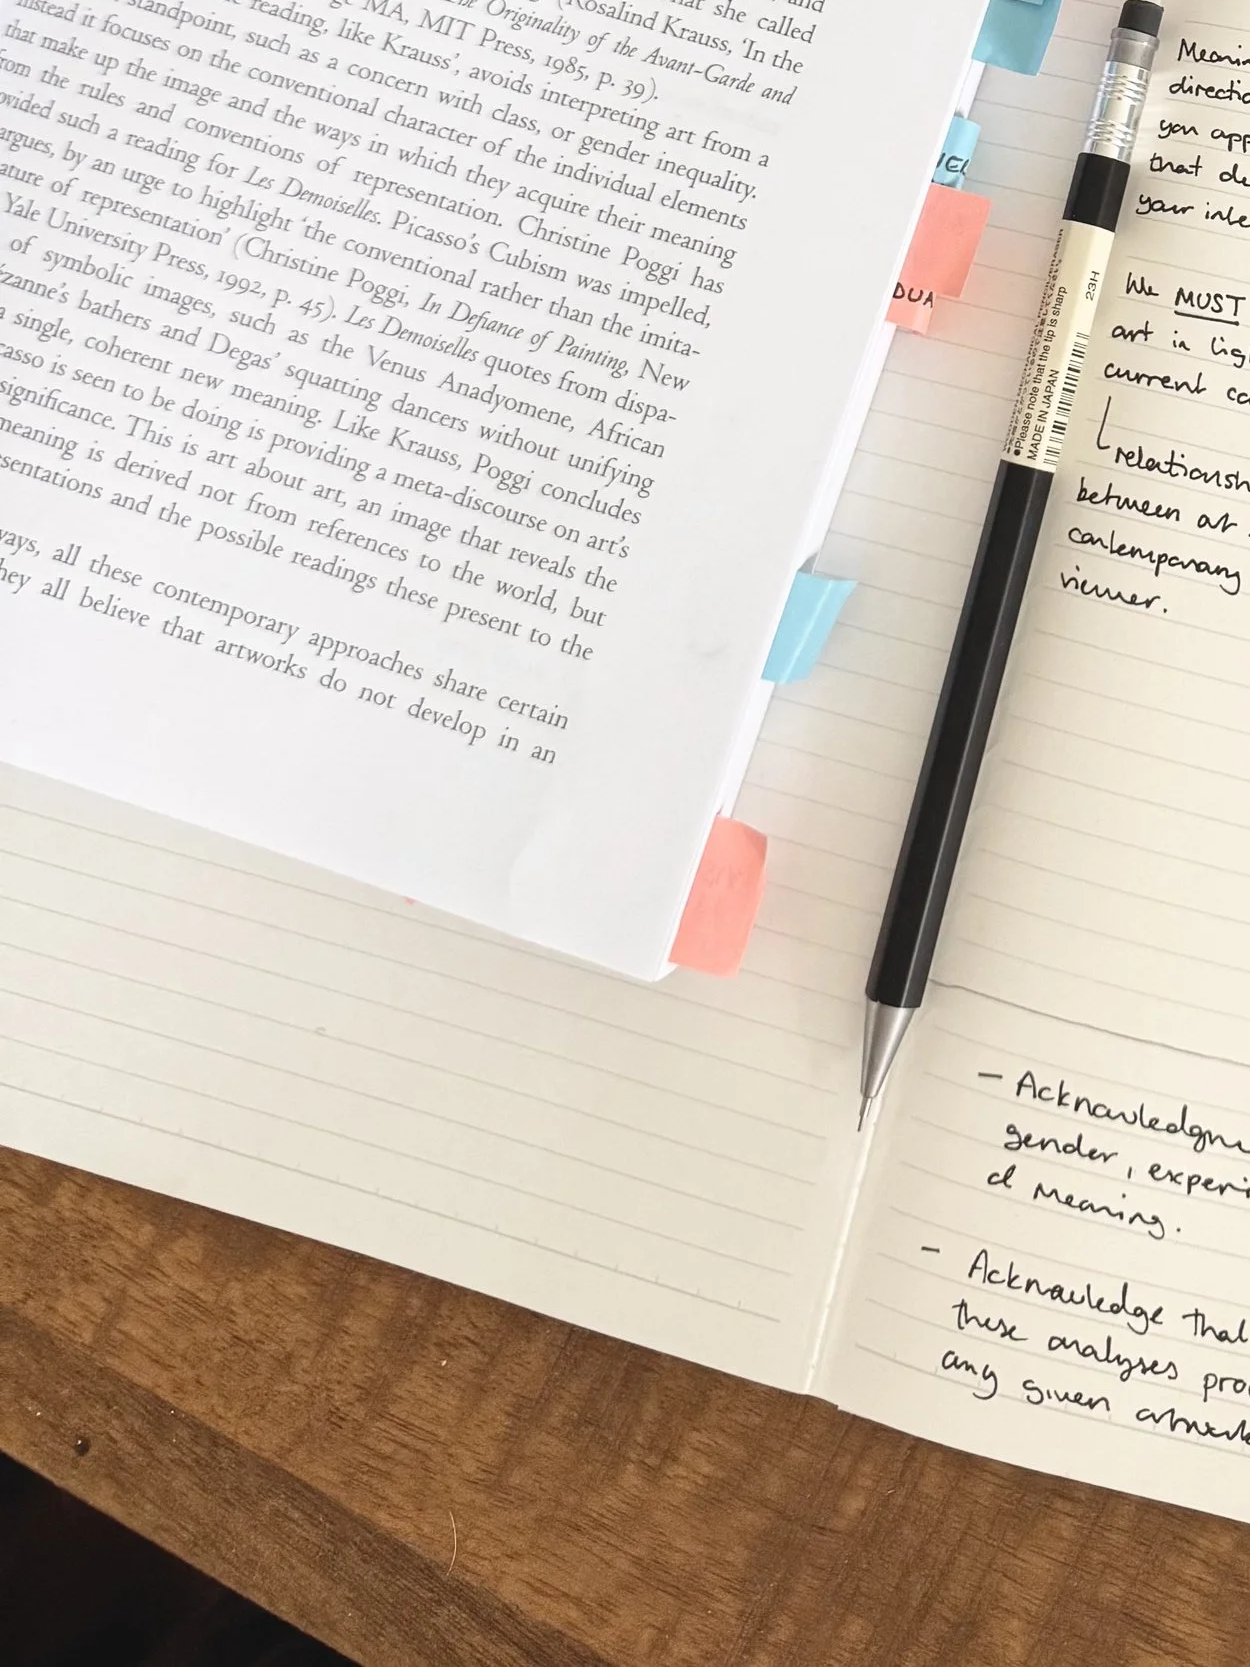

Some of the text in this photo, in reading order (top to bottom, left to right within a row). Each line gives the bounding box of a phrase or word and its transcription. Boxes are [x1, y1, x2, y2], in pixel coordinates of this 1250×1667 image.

[417, 8, 590, 82] MIT 1985,
[659, 14, 733, 56] Krauss,
[756, 15, 817, 44] called
[539, 82, 752, 163] interpreting art from
[577, 135, 757, 204] gender inequality.
[1148, 152, 1204, 178] that
[552, 155, 748, 231] individual elements
[488, 241, 568, 283] Cubism
[517, 211, 729, 294] Christine Poggi has
[1050, 286, 1068, 317] sharp
[1085, 270, 1101, 302] 23H
[1167, 286, 1247, 327] MUST
[1042, 329, 1056, 343] tip
[1046, 318, 1058, 328] is
[554, 333, 691, 392] Painting, New
[1031, 363, 1047, 385] that
[1037, 344, 1051, 362] the
[1026, 385, 1040, 411] note
[1103, 362, 1208, 403] current
[1026, 368, 1060, 461] MADE IN JAPAN
[586, 417, 665, 459] African
[471, 452, 648, 525] Poggi concludes
[567, 453, 656, 499] unifying
[1075, 476, 1181, 523] between
[1003, 1123, 1119, 1164] gender
[961, 1248, 1164, 1336] Acknowledge
[1181, 1307, 1249, 1345] that
[1021, 1378, 1111, 1413] given
